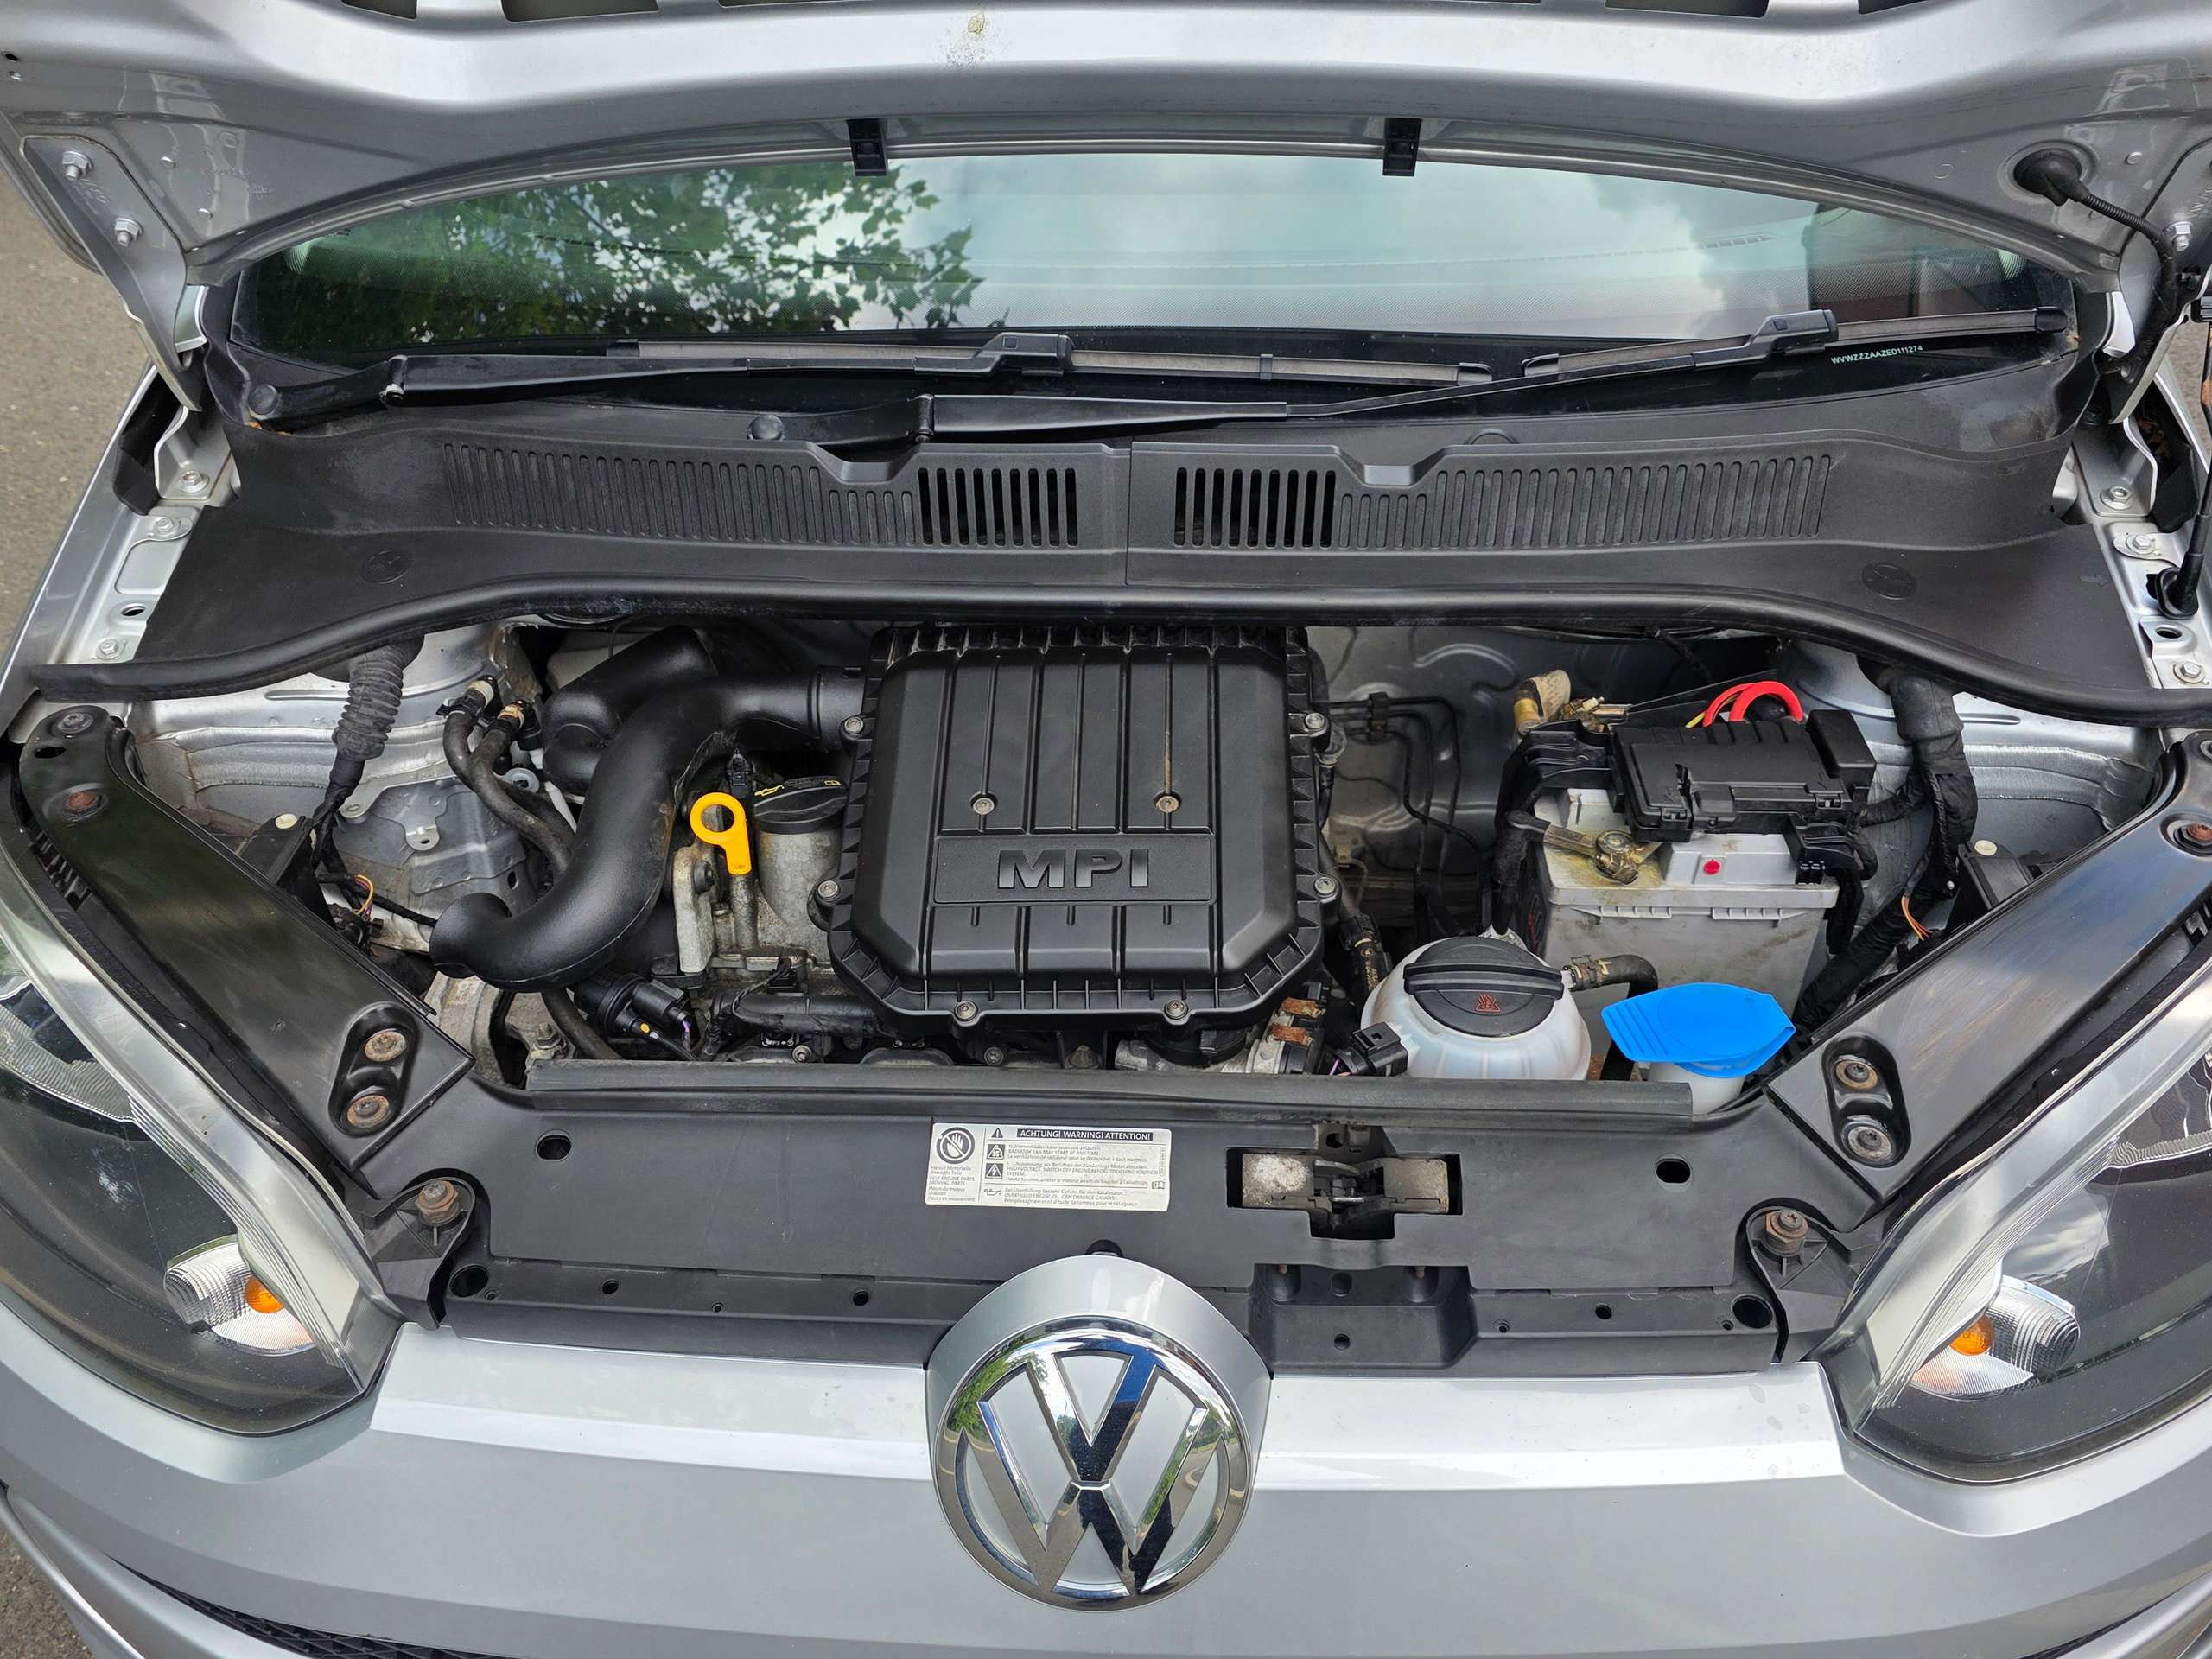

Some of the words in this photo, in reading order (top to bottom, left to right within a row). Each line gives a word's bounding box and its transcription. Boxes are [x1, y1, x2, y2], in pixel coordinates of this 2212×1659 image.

[997, 849, 1149, 890] MPI
[1020, 1129, 1060, 1138] ACHTUNG!
[1063, 1130, 1103, 1139] WARNING!
[1105, 1132, 1151, 1141] ATTENTION!
[956, 1341, 1232, 1599] VW
